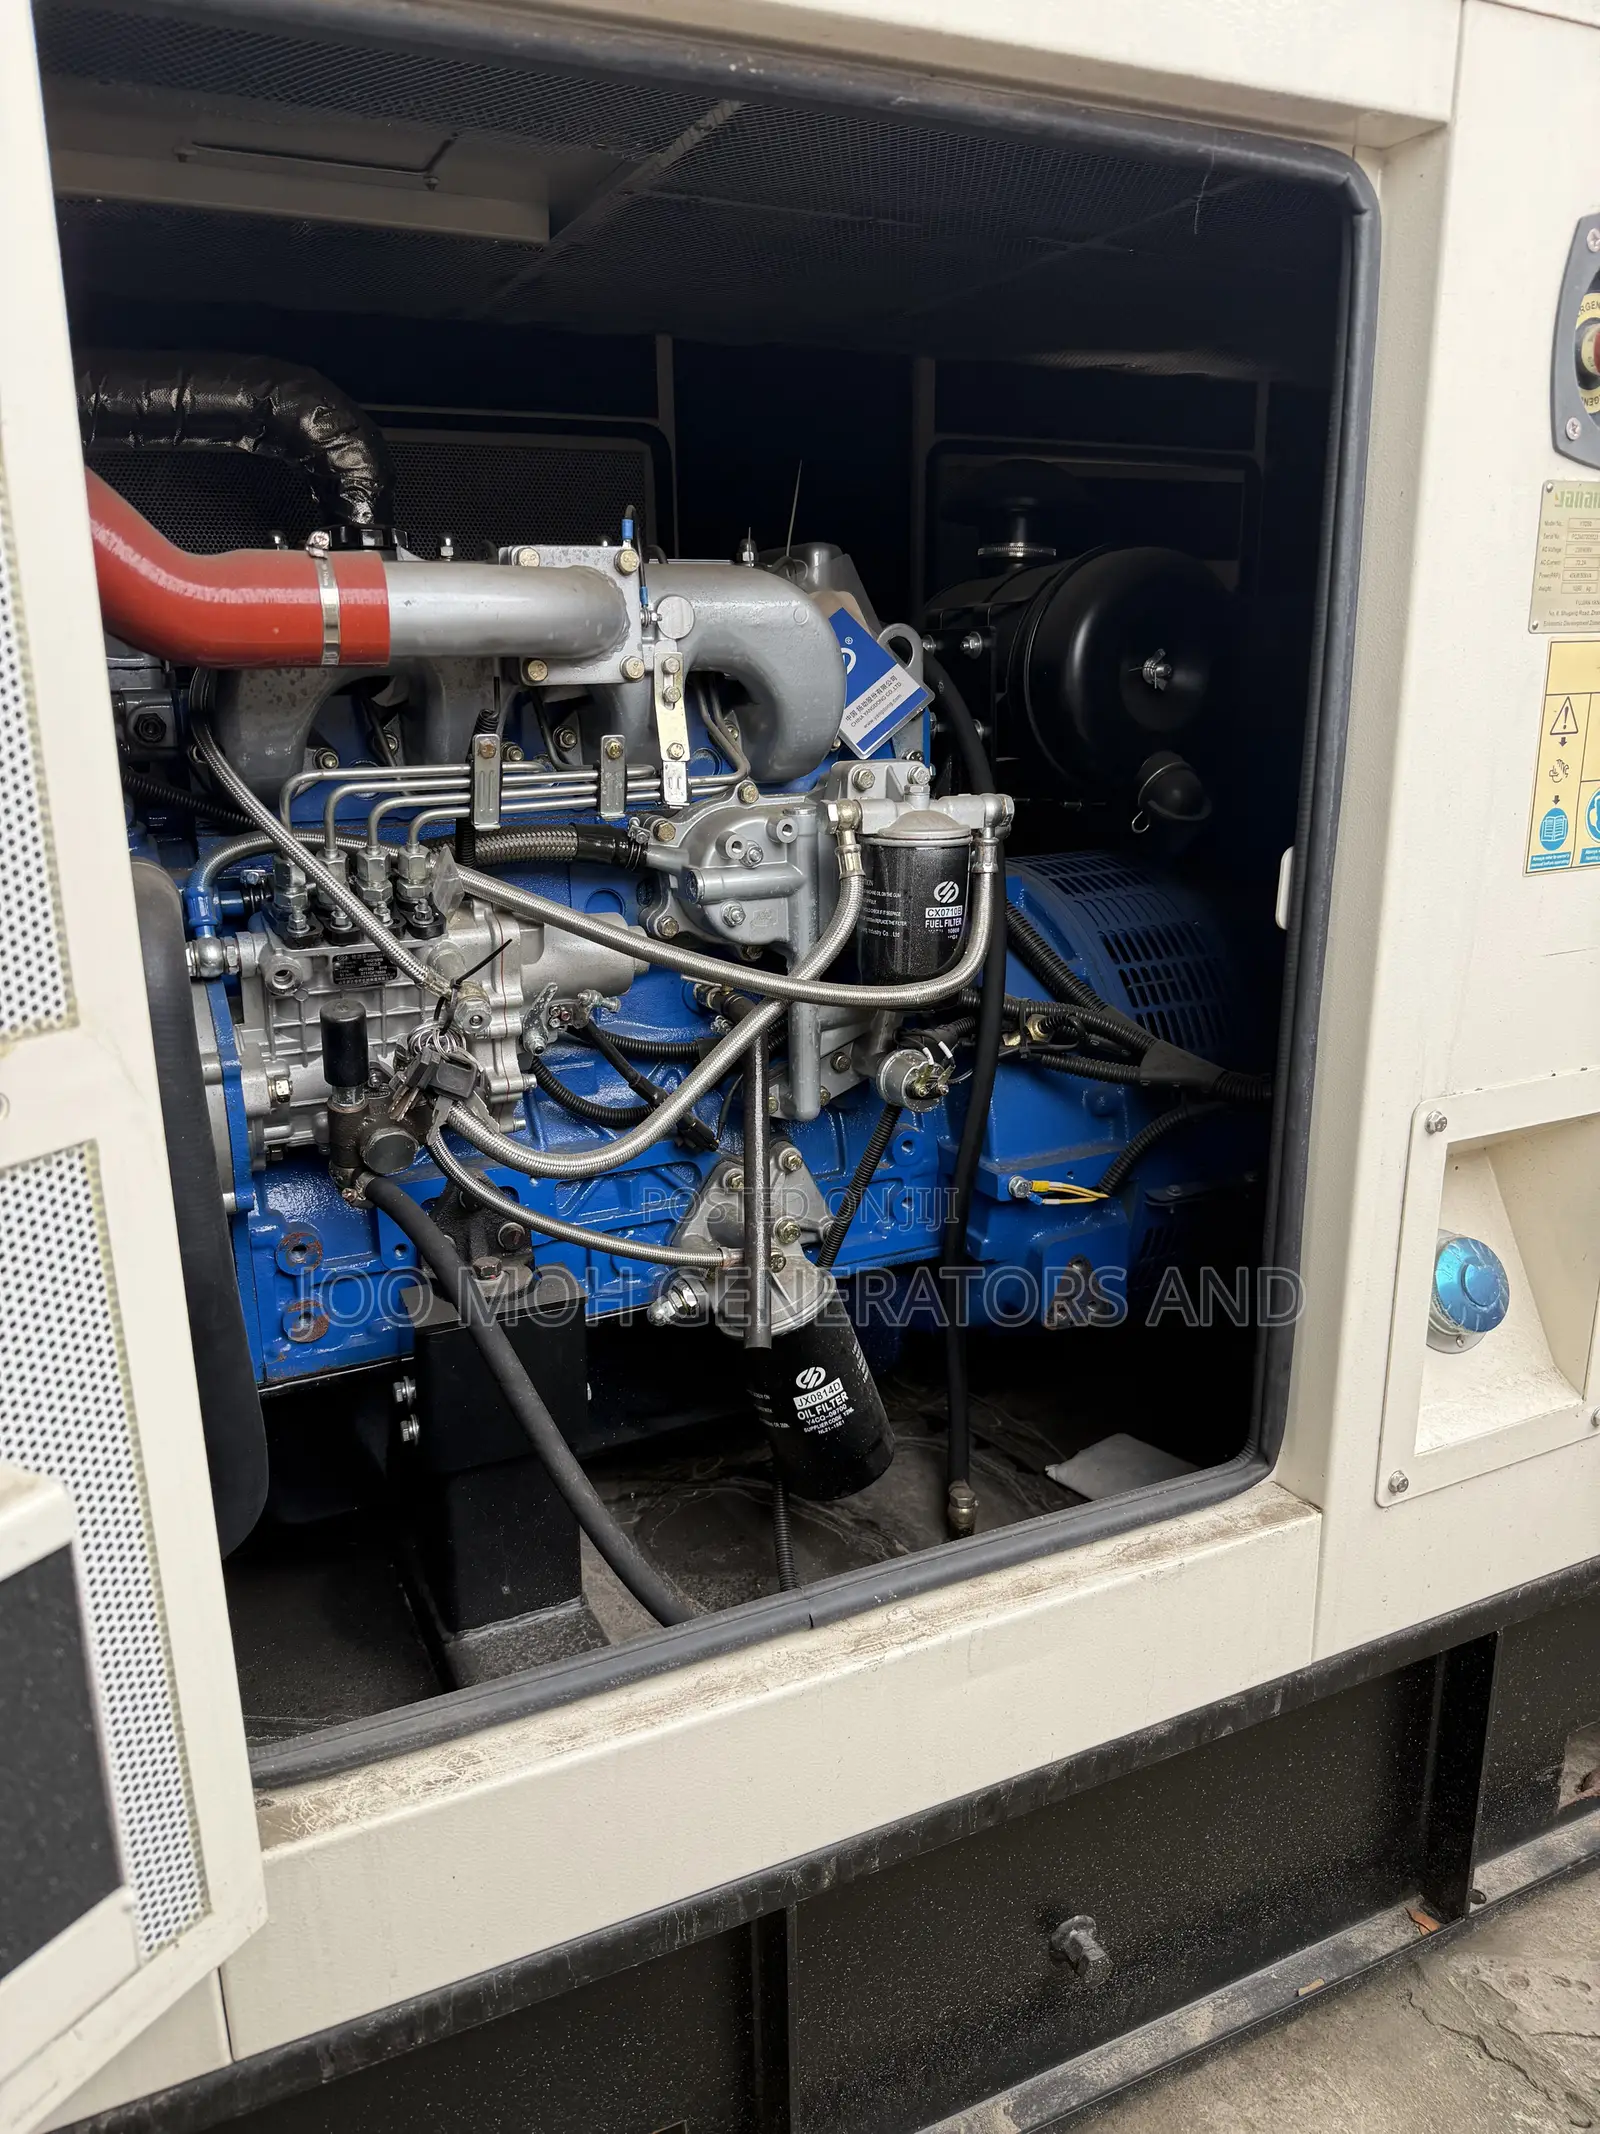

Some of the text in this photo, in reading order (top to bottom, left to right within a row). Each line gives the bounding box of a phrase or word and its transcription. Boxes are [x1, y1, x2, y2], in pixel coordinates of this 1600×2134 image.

[927, 907, 962, 917] CX0710B
[925, 917, 962, 928] FUEL FILTER
[798, 1381, 841, 1407] JX0814D
[797, 1391, 849, 1421] OIL FILTER
